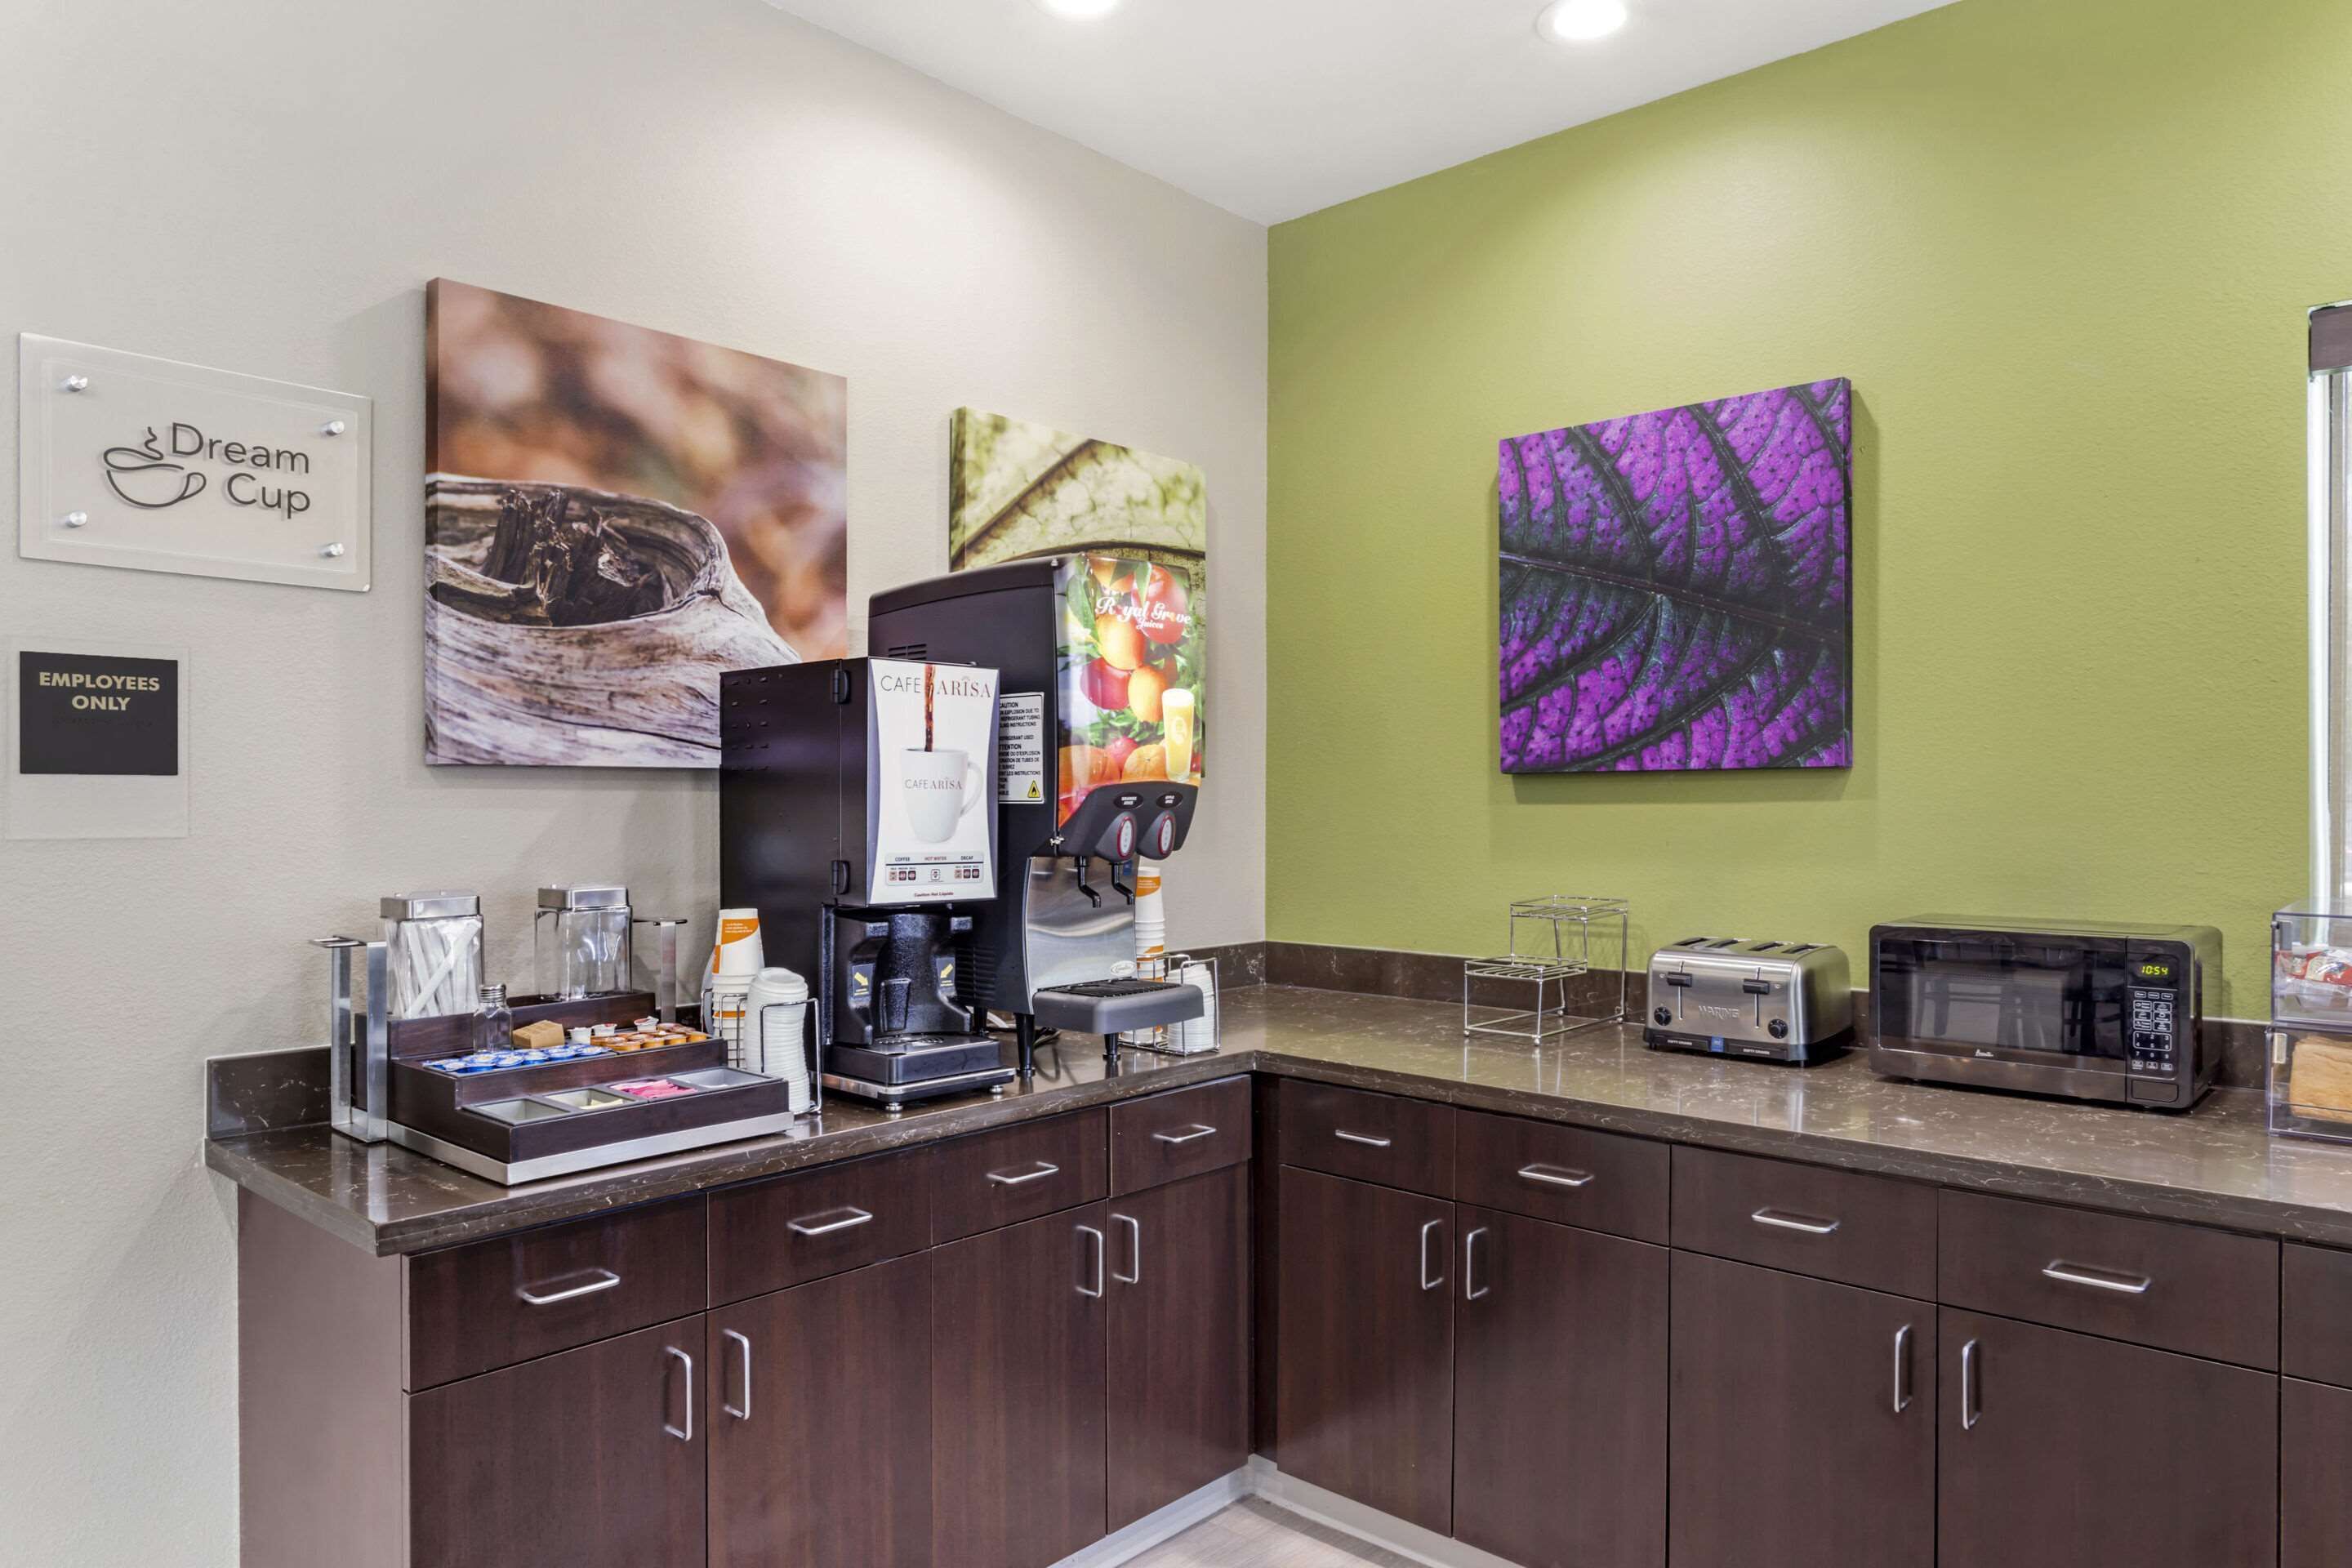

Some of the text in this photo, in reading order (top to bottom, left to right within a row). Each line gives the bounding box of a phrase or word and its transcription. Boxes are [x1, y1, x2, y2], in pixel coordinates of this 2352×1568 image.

[172, 422, 310, 474] Dream
[227, 473, 310, 519] Cup
[39, 671, 160, 692] EMPLOYEES
[880, 675, 921, 693] CAFE
[72, 695, 131, 711] ONLY
[905, 778, 928, 789] CAFE
